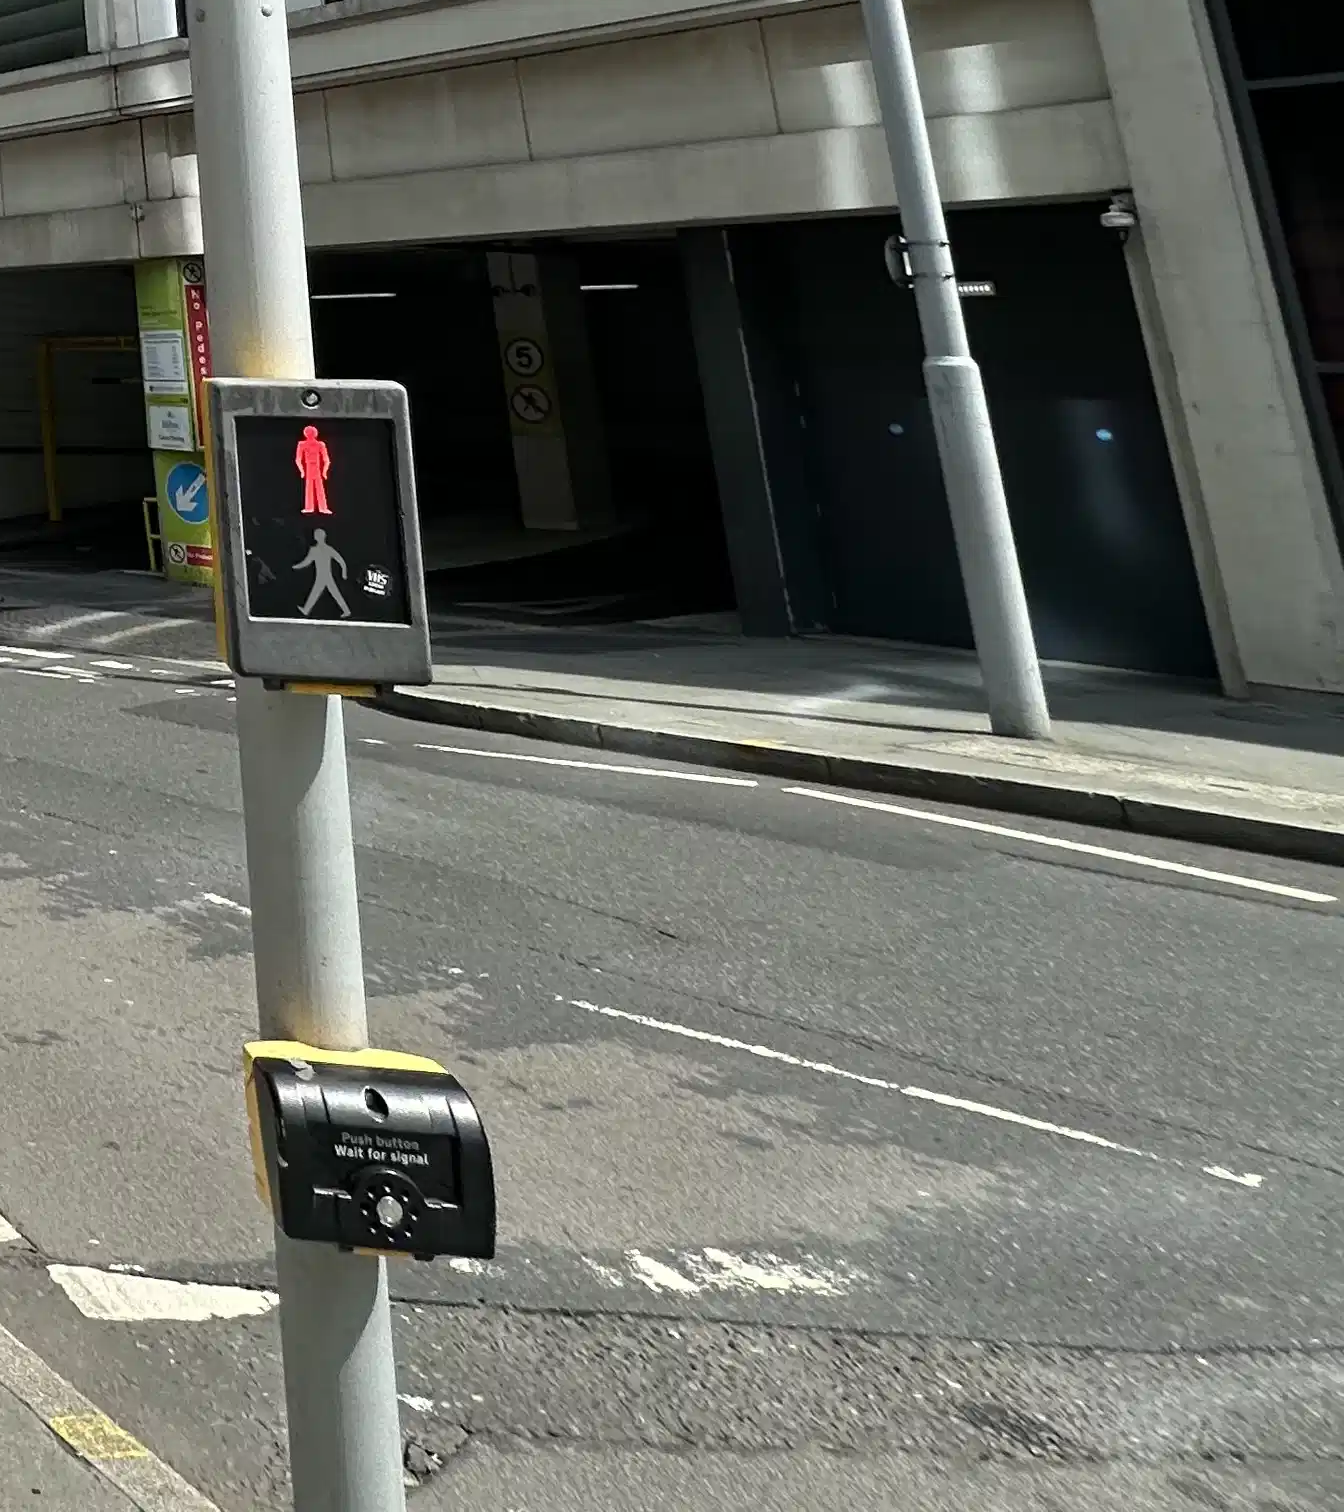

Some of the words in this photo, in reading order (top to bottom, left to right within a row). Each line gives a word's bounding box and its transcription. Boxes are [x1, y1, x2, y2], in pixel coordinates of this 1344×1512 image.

[516, 347, 533, 368] 5
[341, 1131, 373, 1146] Push
[375, 1134, 420, 1151] button
[334, 1144, 365, 1160] Wait
[367, 1147, 387, 1161] for
[390, 1150, 430, 1166] signal
